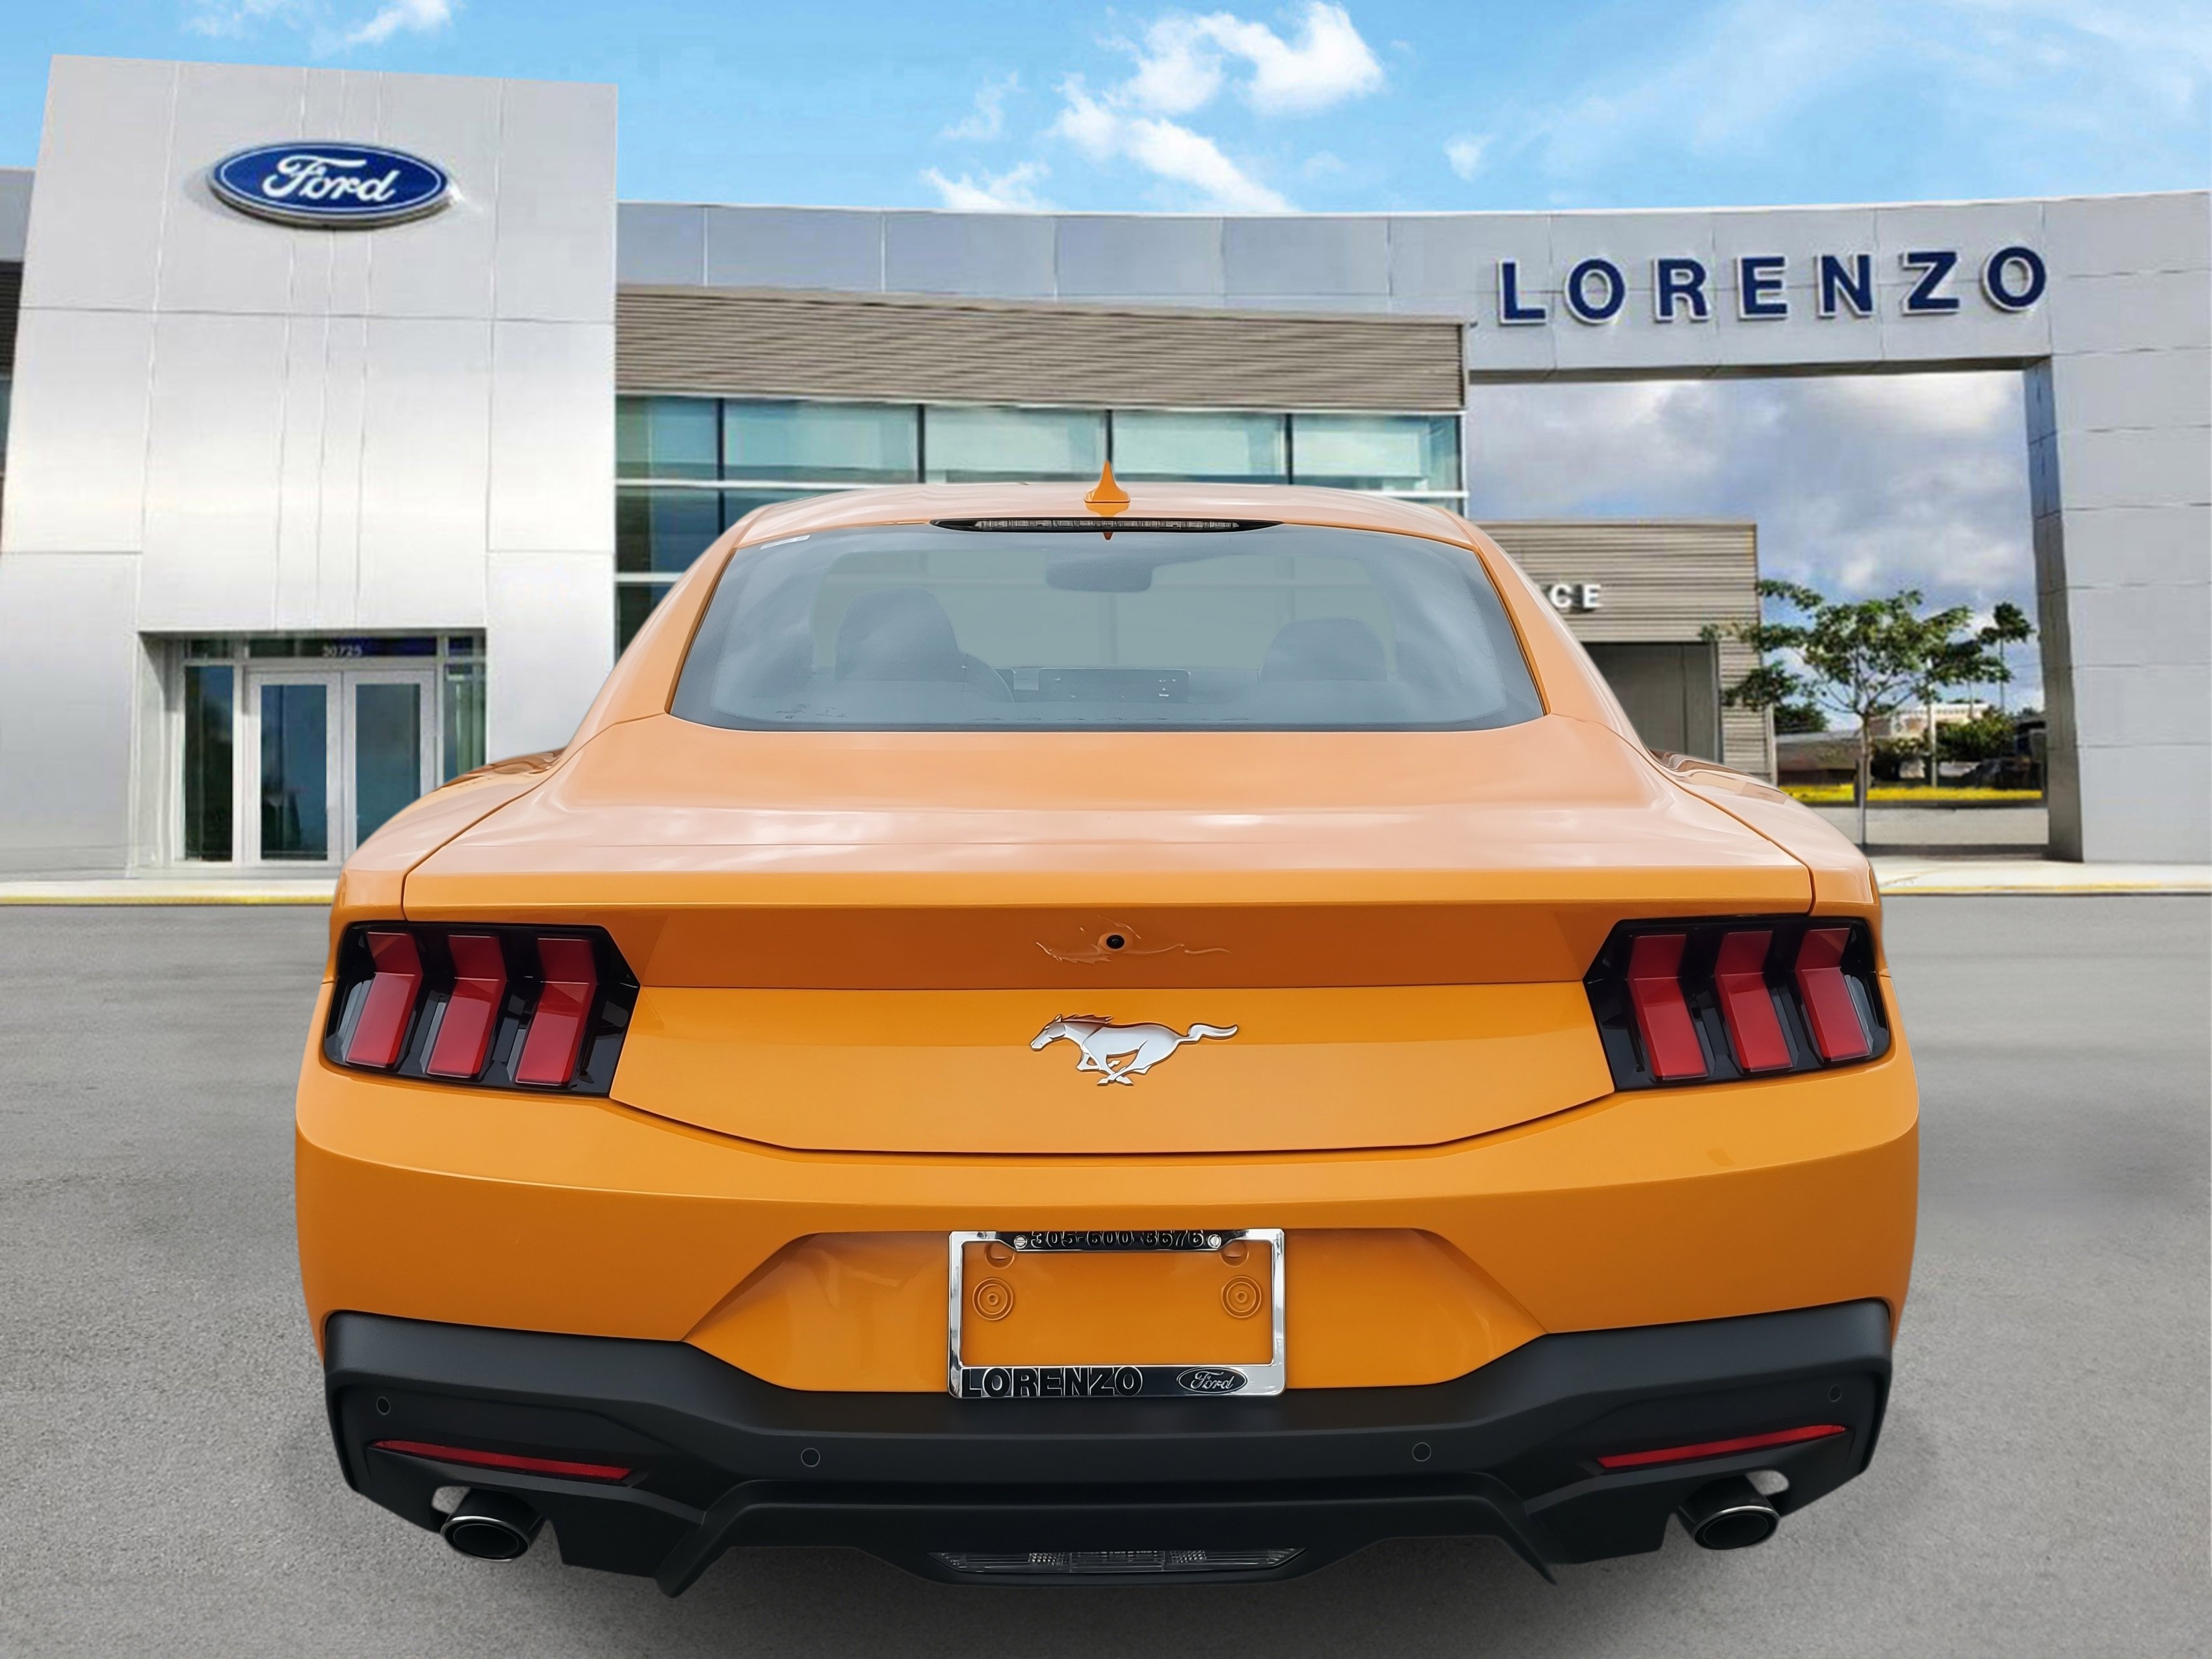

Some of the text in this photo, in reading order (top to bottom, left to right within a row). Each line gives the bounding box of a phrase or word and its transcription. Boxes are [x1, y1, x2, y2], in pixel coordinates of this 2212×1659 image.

[262, 155, 400, 202] Ford
[1498, 246, 2047, 325] LORENZO
[961, 1366, 1143, 1397] LORENZO
[1190, 1368, 1234, 1391] Ford
